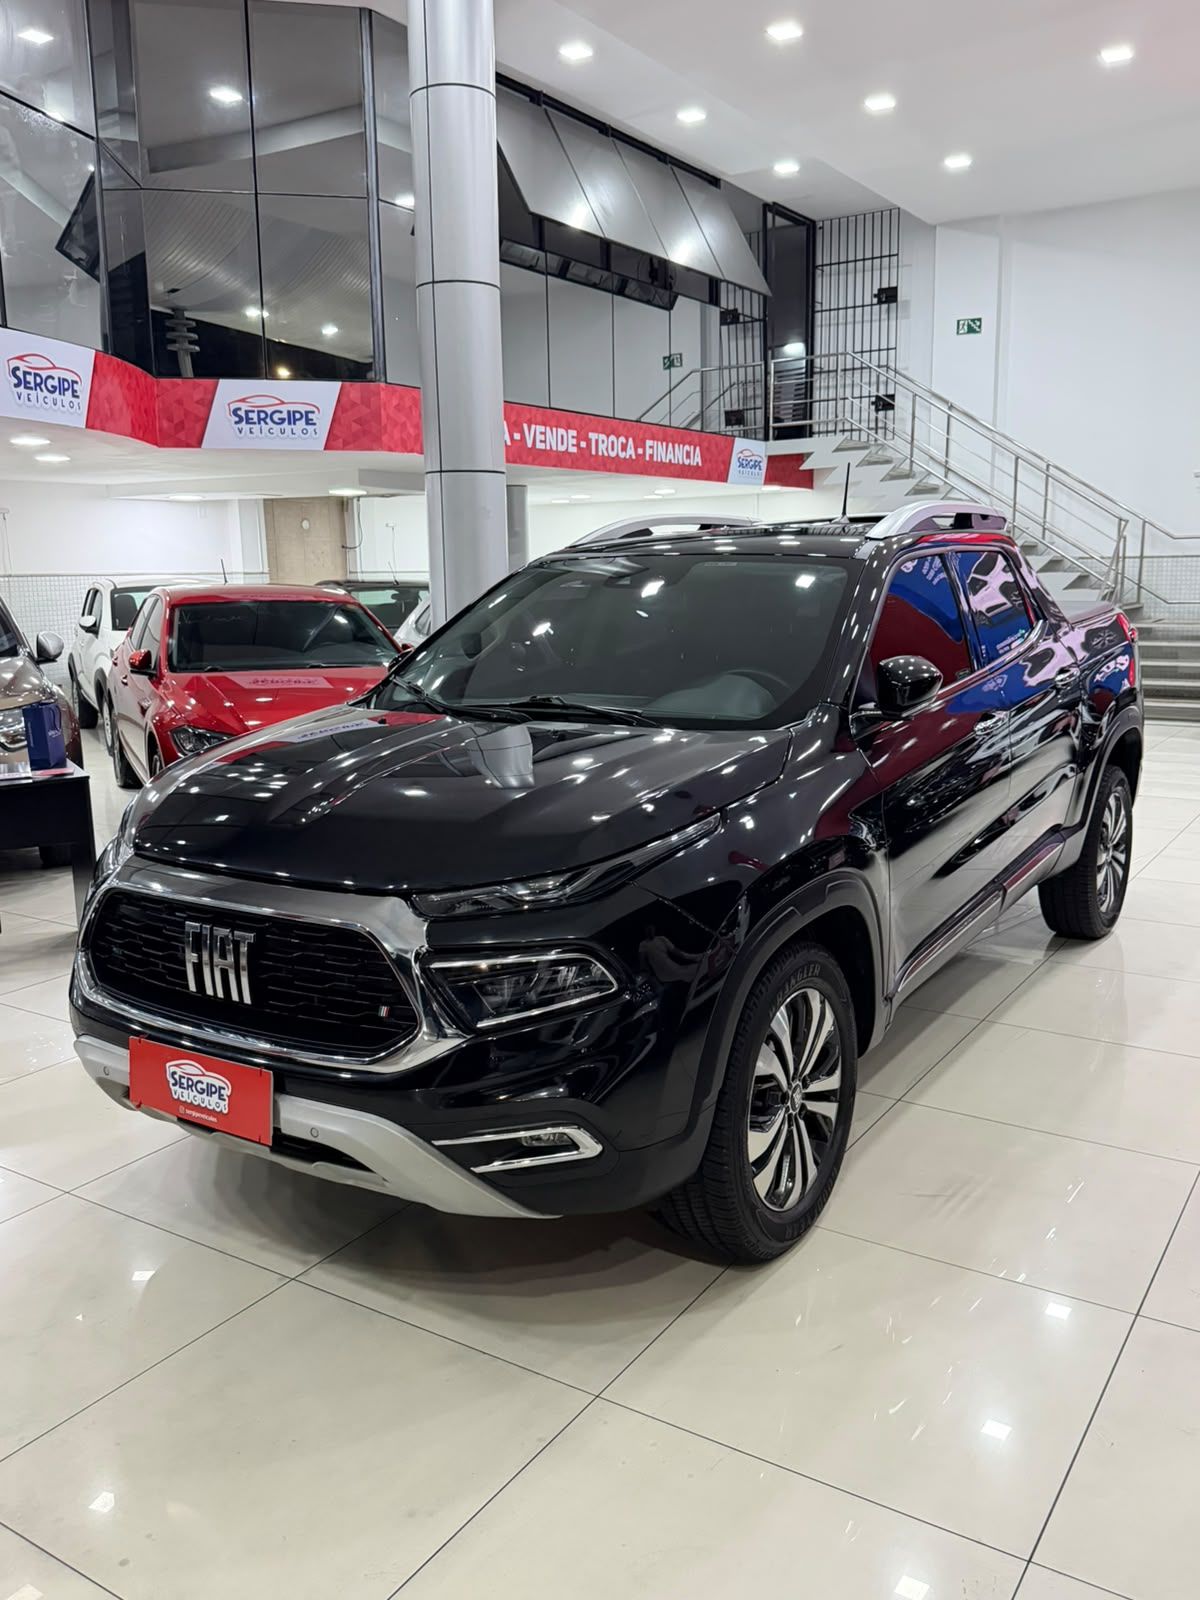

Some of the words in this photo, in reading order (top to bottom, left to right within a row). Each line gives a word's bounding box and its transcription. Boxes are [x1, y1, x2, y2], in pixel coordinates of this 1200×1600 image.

[11, 366, 80, 399] SERGIPE
[16, 391, 81, 410] VEÍCULOS
[232, 407, 317, 426] SERGIPE
[237, 425, 318, 436] VEÍCULOS
[522, 422, 577, 453] VENDE
[588, 432, 636, 460] TROCA
[645, 439, 702, 466] FINANCIA
[184, 921, 256, 1005] FIAT
[170, 1070, 227, 1102] SERGIPE
